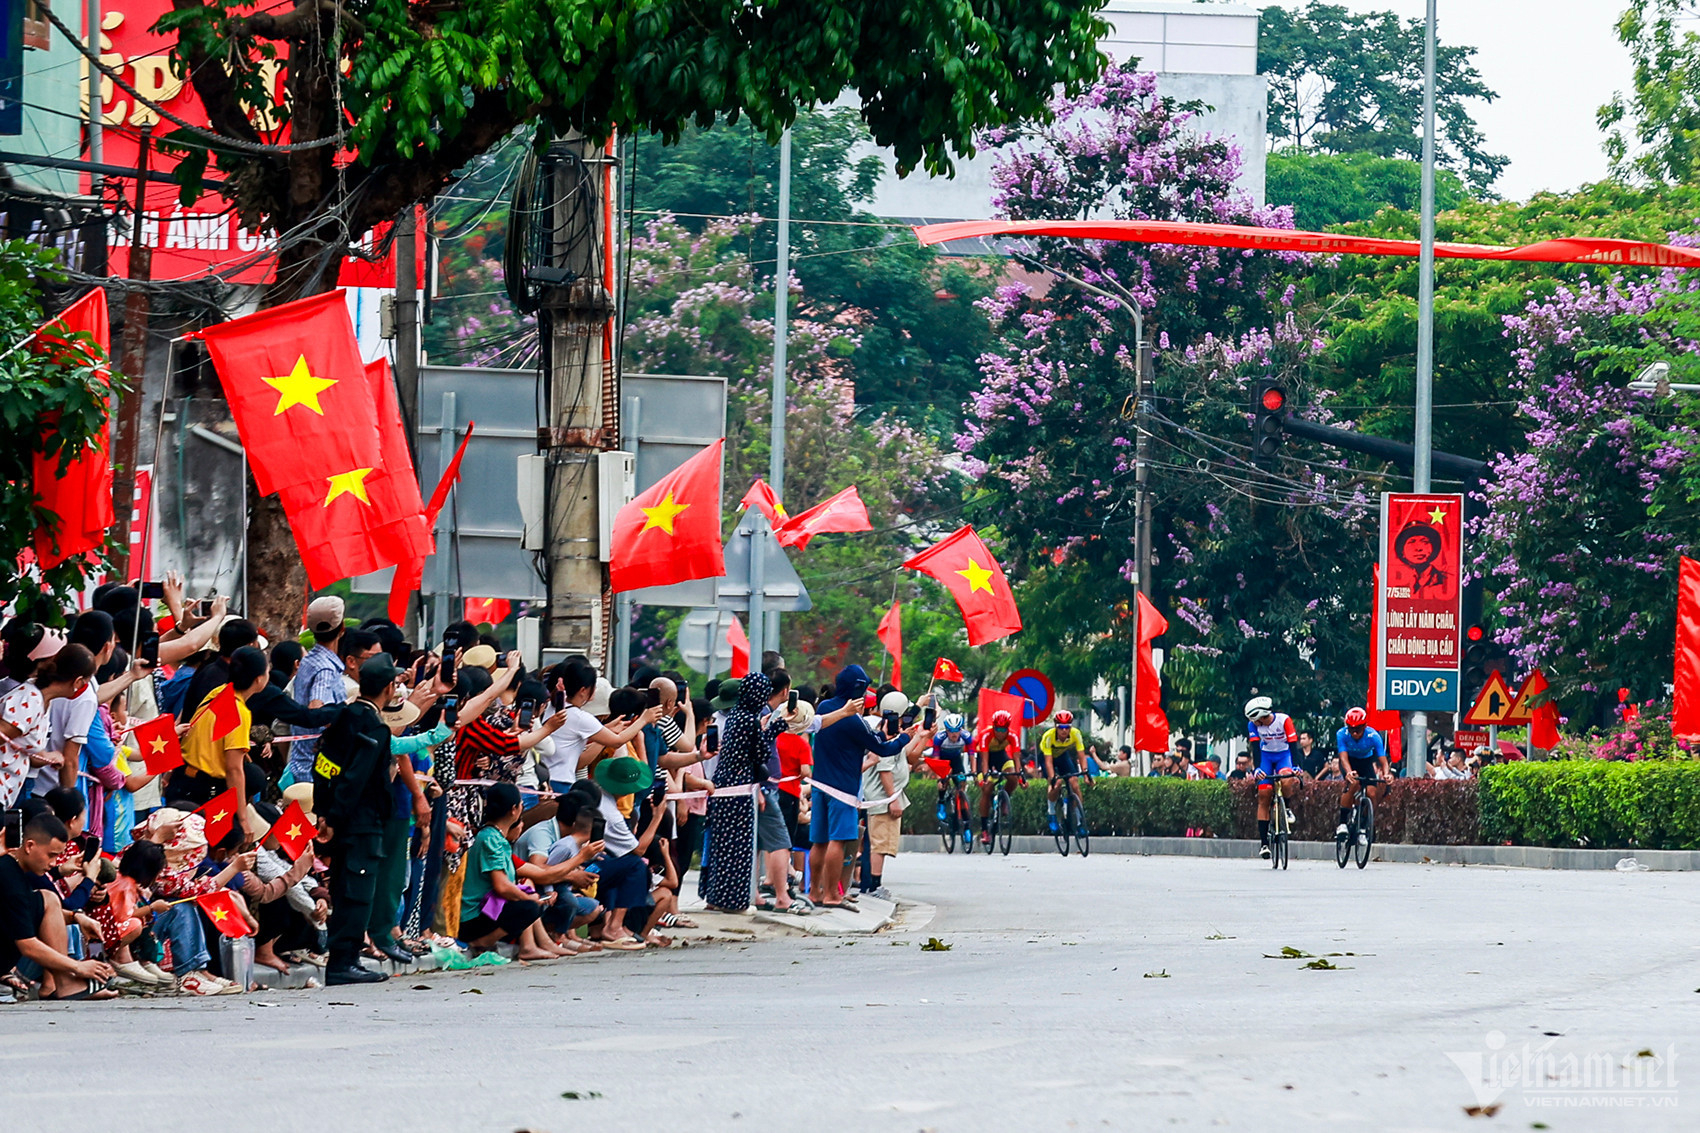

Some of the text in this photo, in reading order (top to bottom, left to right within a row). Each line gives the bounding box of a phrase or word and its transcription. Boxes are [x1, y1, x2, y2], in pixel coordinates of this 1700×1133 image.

[1419, 610, 1435, 629] NĂM
[1388, 633, 1406, 654] CHẤN
[1391, 680, 1433, 696] BIDV
